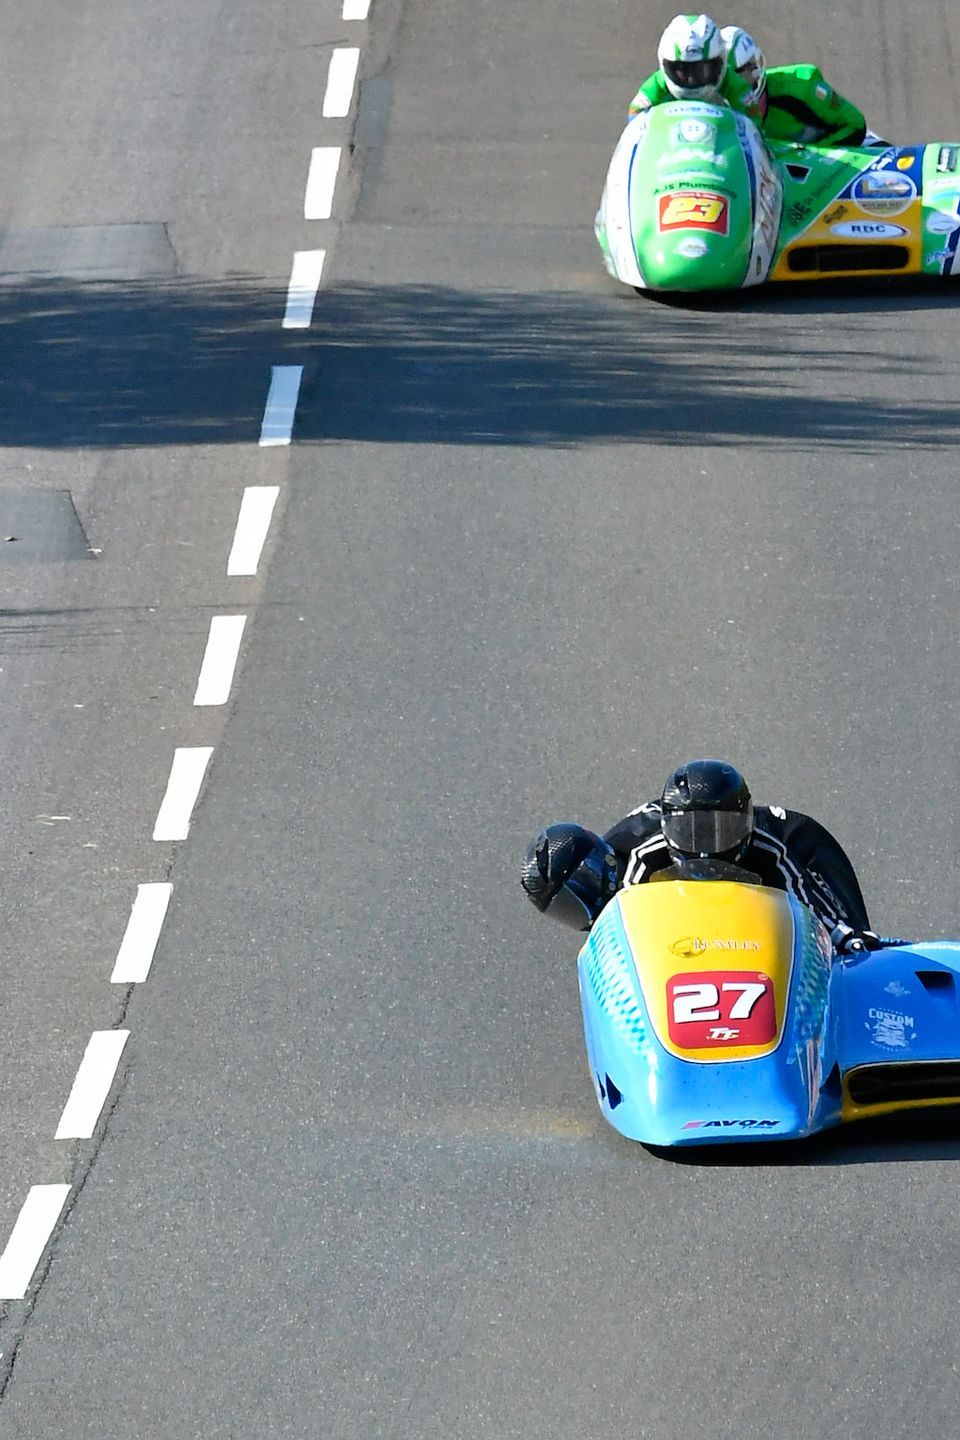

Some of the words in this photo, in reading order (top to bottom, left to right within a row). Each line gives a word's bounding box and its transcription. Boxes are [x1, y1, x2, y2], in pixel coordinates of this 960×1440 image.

[661, 197, 724, 225] 23
[851, 224, 886, 233] RDC
[672, 982, 768, 1024] 27
[868, 1007, 914, 1029] CUSTOM
[702, 1119, 781, 1128] AVON
